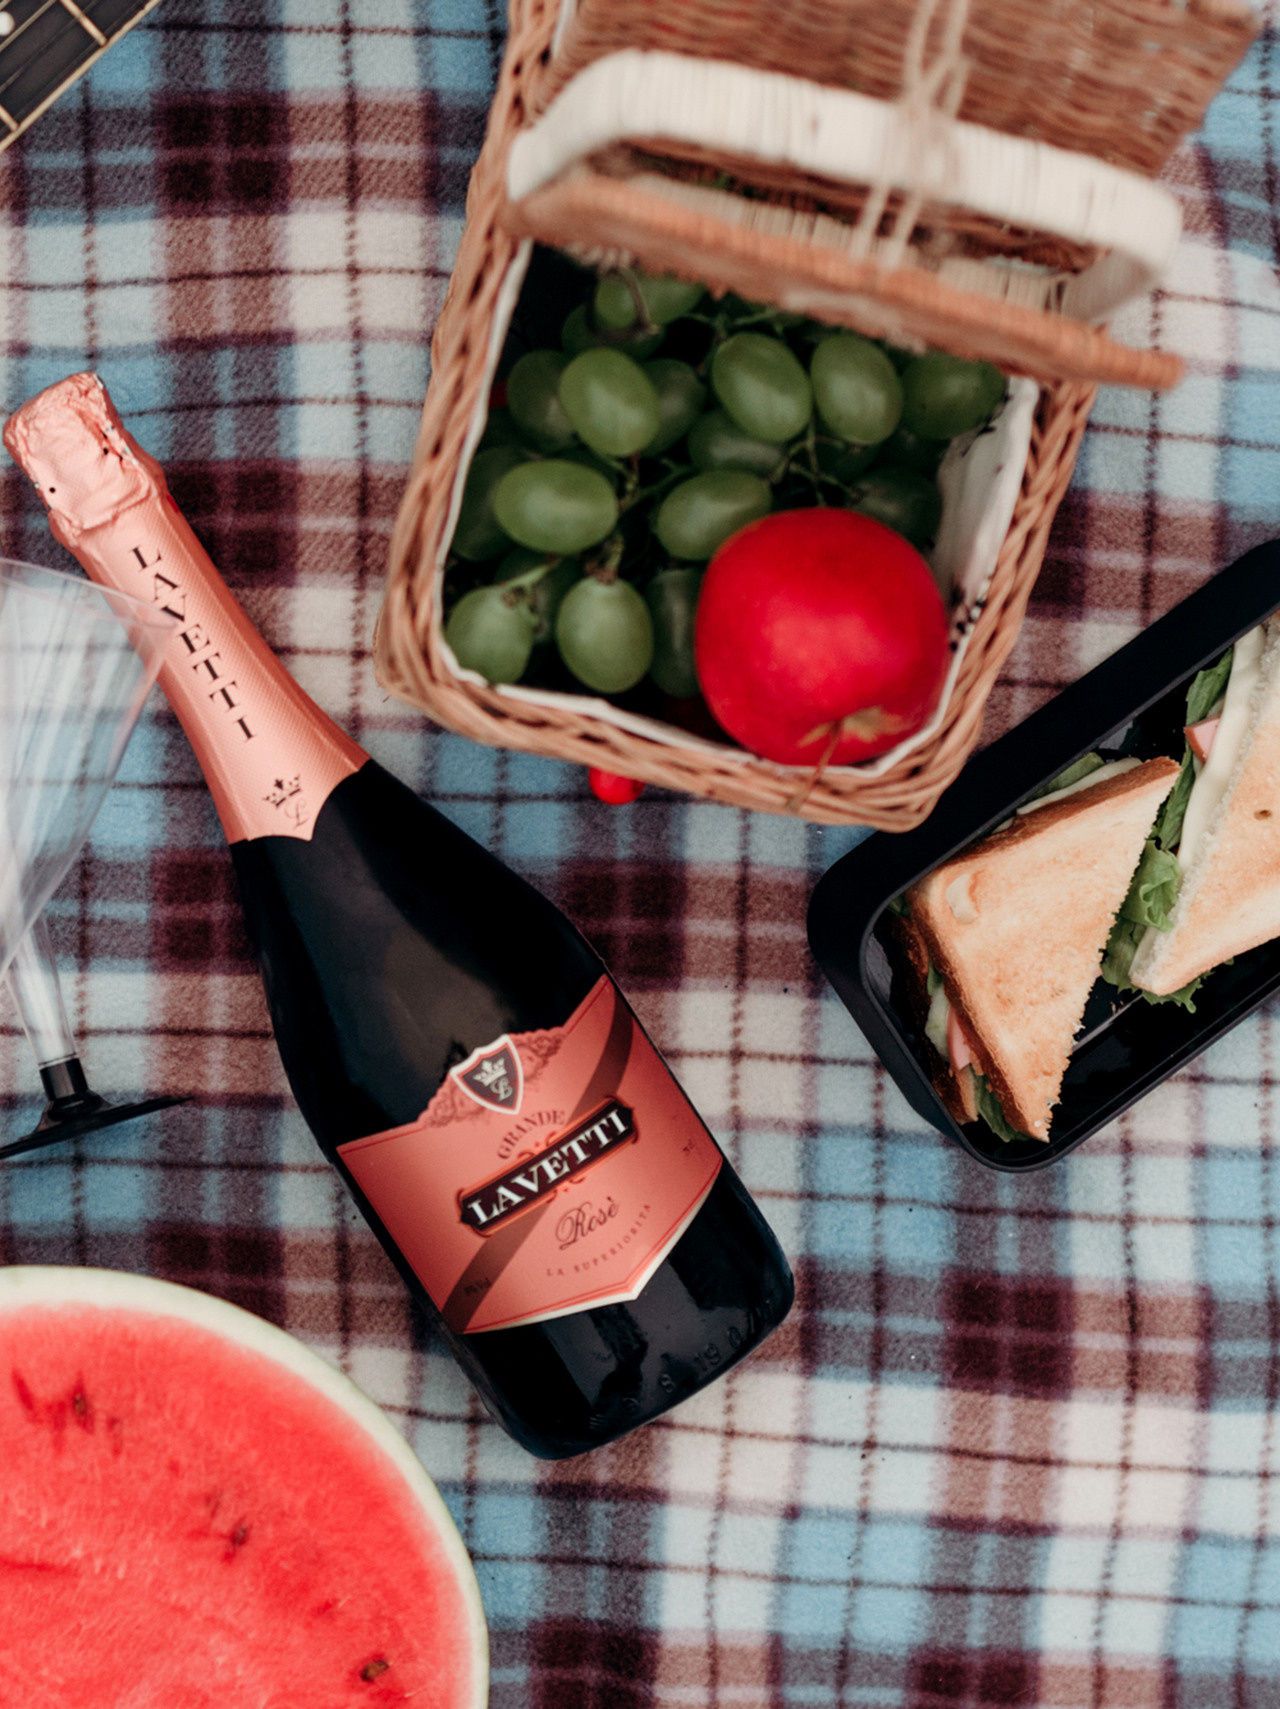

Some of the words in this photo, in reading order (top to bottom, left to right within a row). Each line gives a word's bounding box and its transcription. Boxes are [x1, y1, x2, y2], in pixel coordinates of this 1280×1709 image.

[132, 546, 254, 740] LAVETTI
[468, 1109, 629, 1225] LAVETTI
[497, 1110, 567, 1160] GRANDE
[546, 1268, 564, 1277] LA
